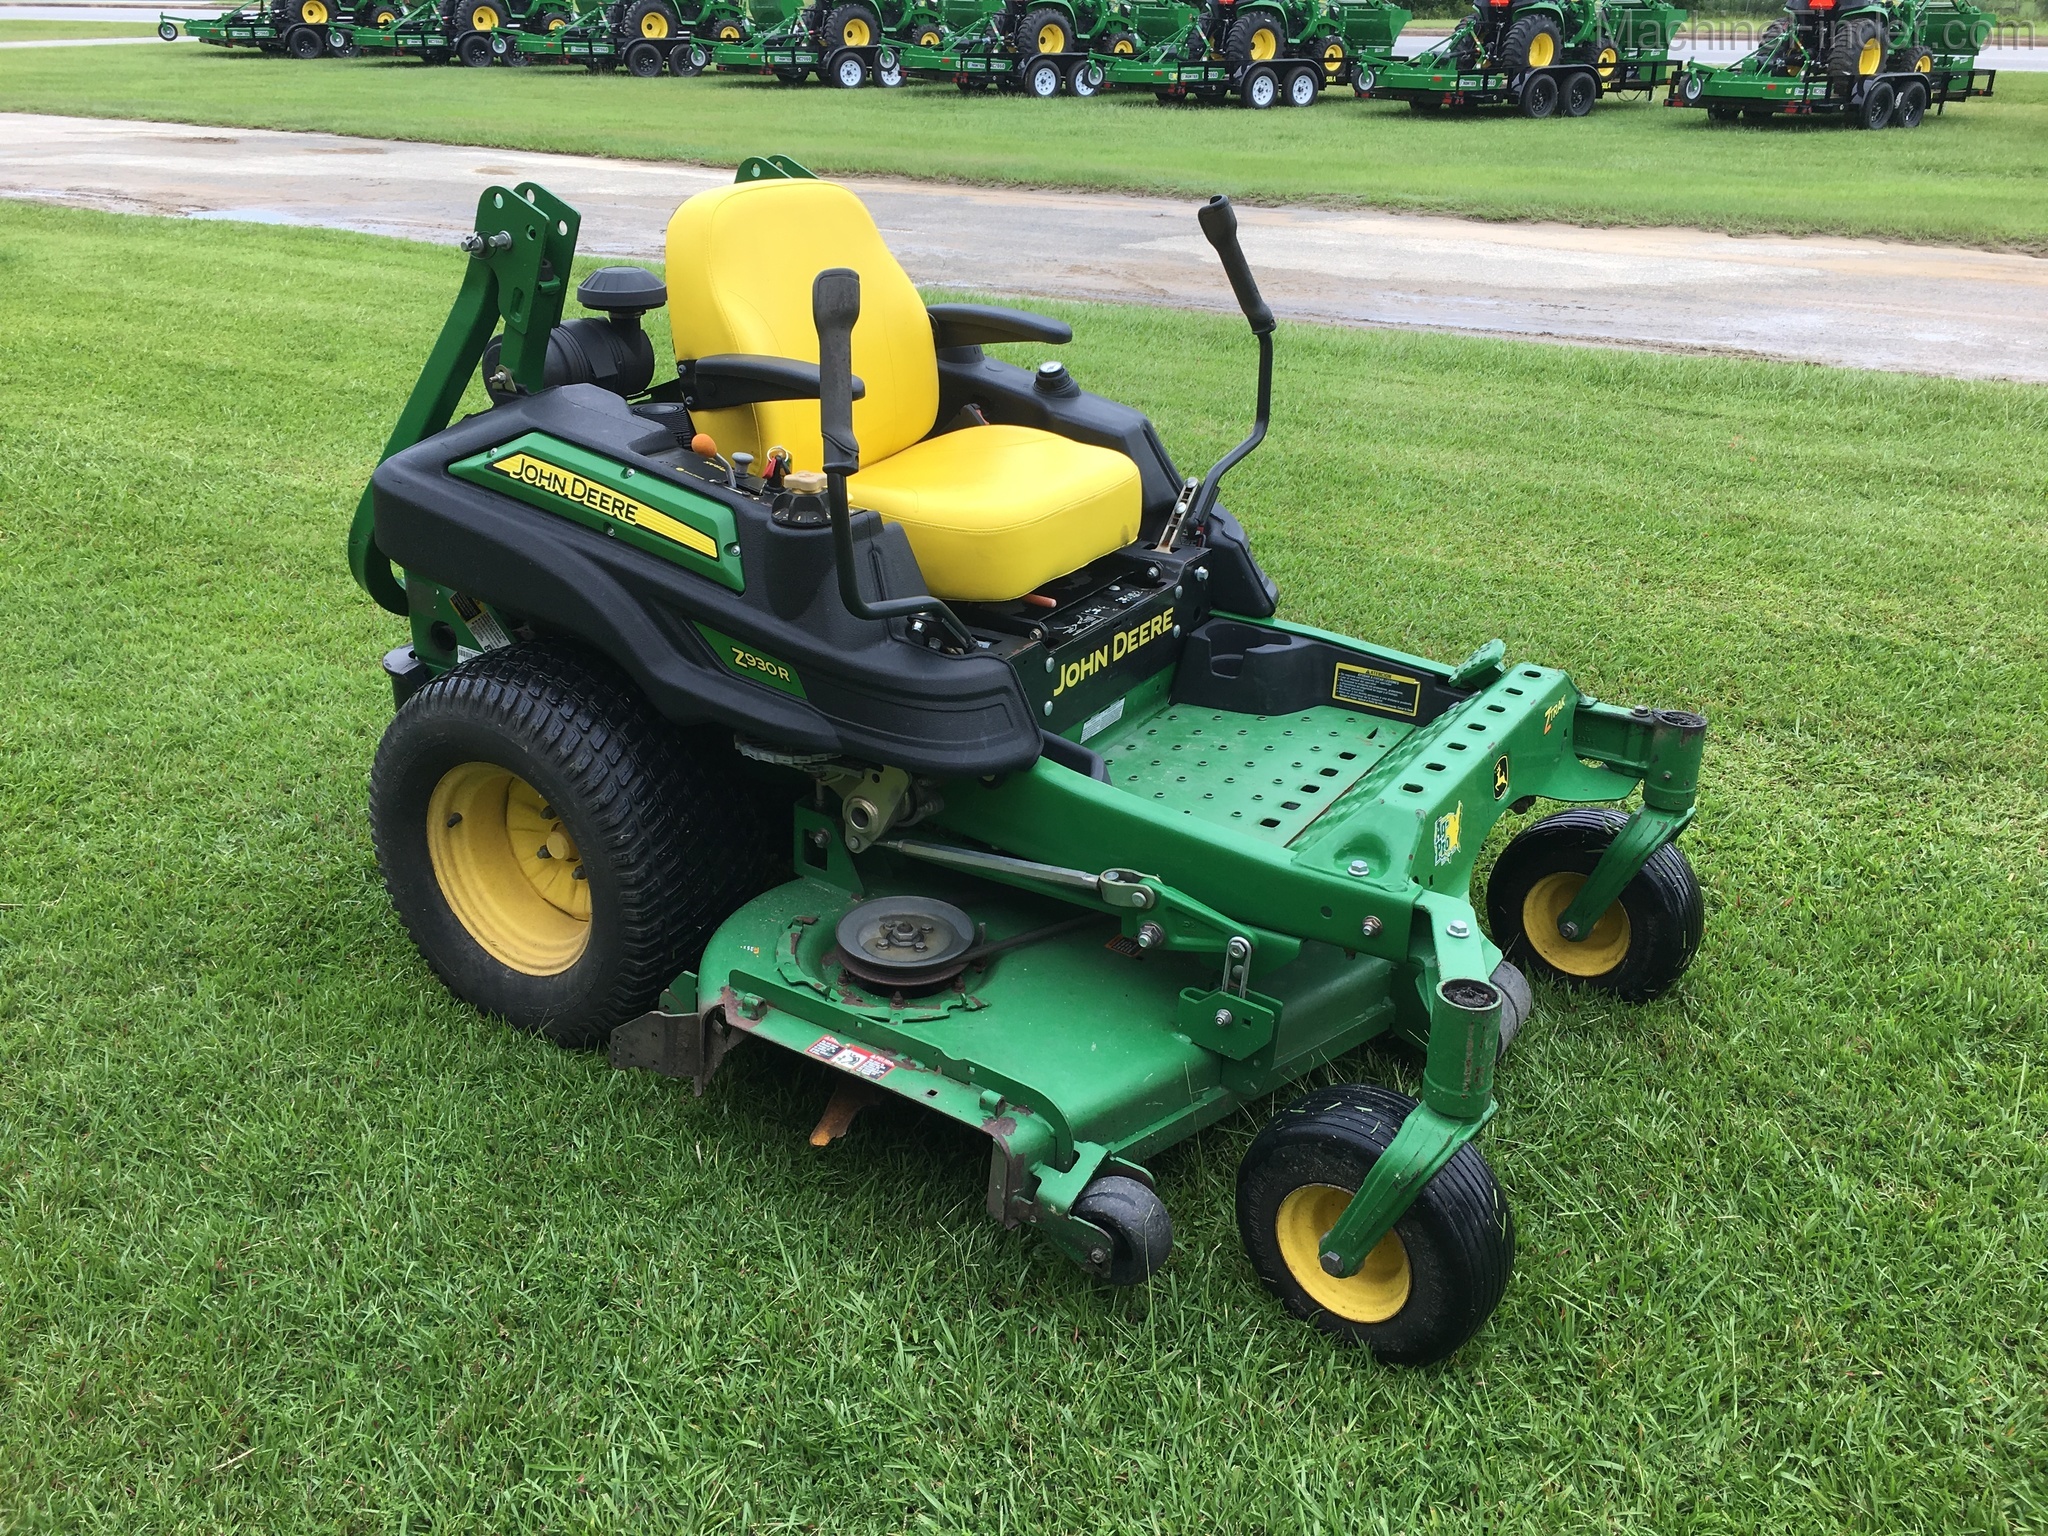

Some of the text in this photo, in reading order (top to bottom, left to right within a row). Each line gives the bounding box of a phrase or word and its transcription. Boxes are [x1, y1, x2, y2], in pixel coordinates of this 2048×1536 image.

[512, 458, 638, 523] JOHN DEERE
[731, 646, 791, 682] Z930R
[1053, 606, 1174, 697] JOHN DEERE
